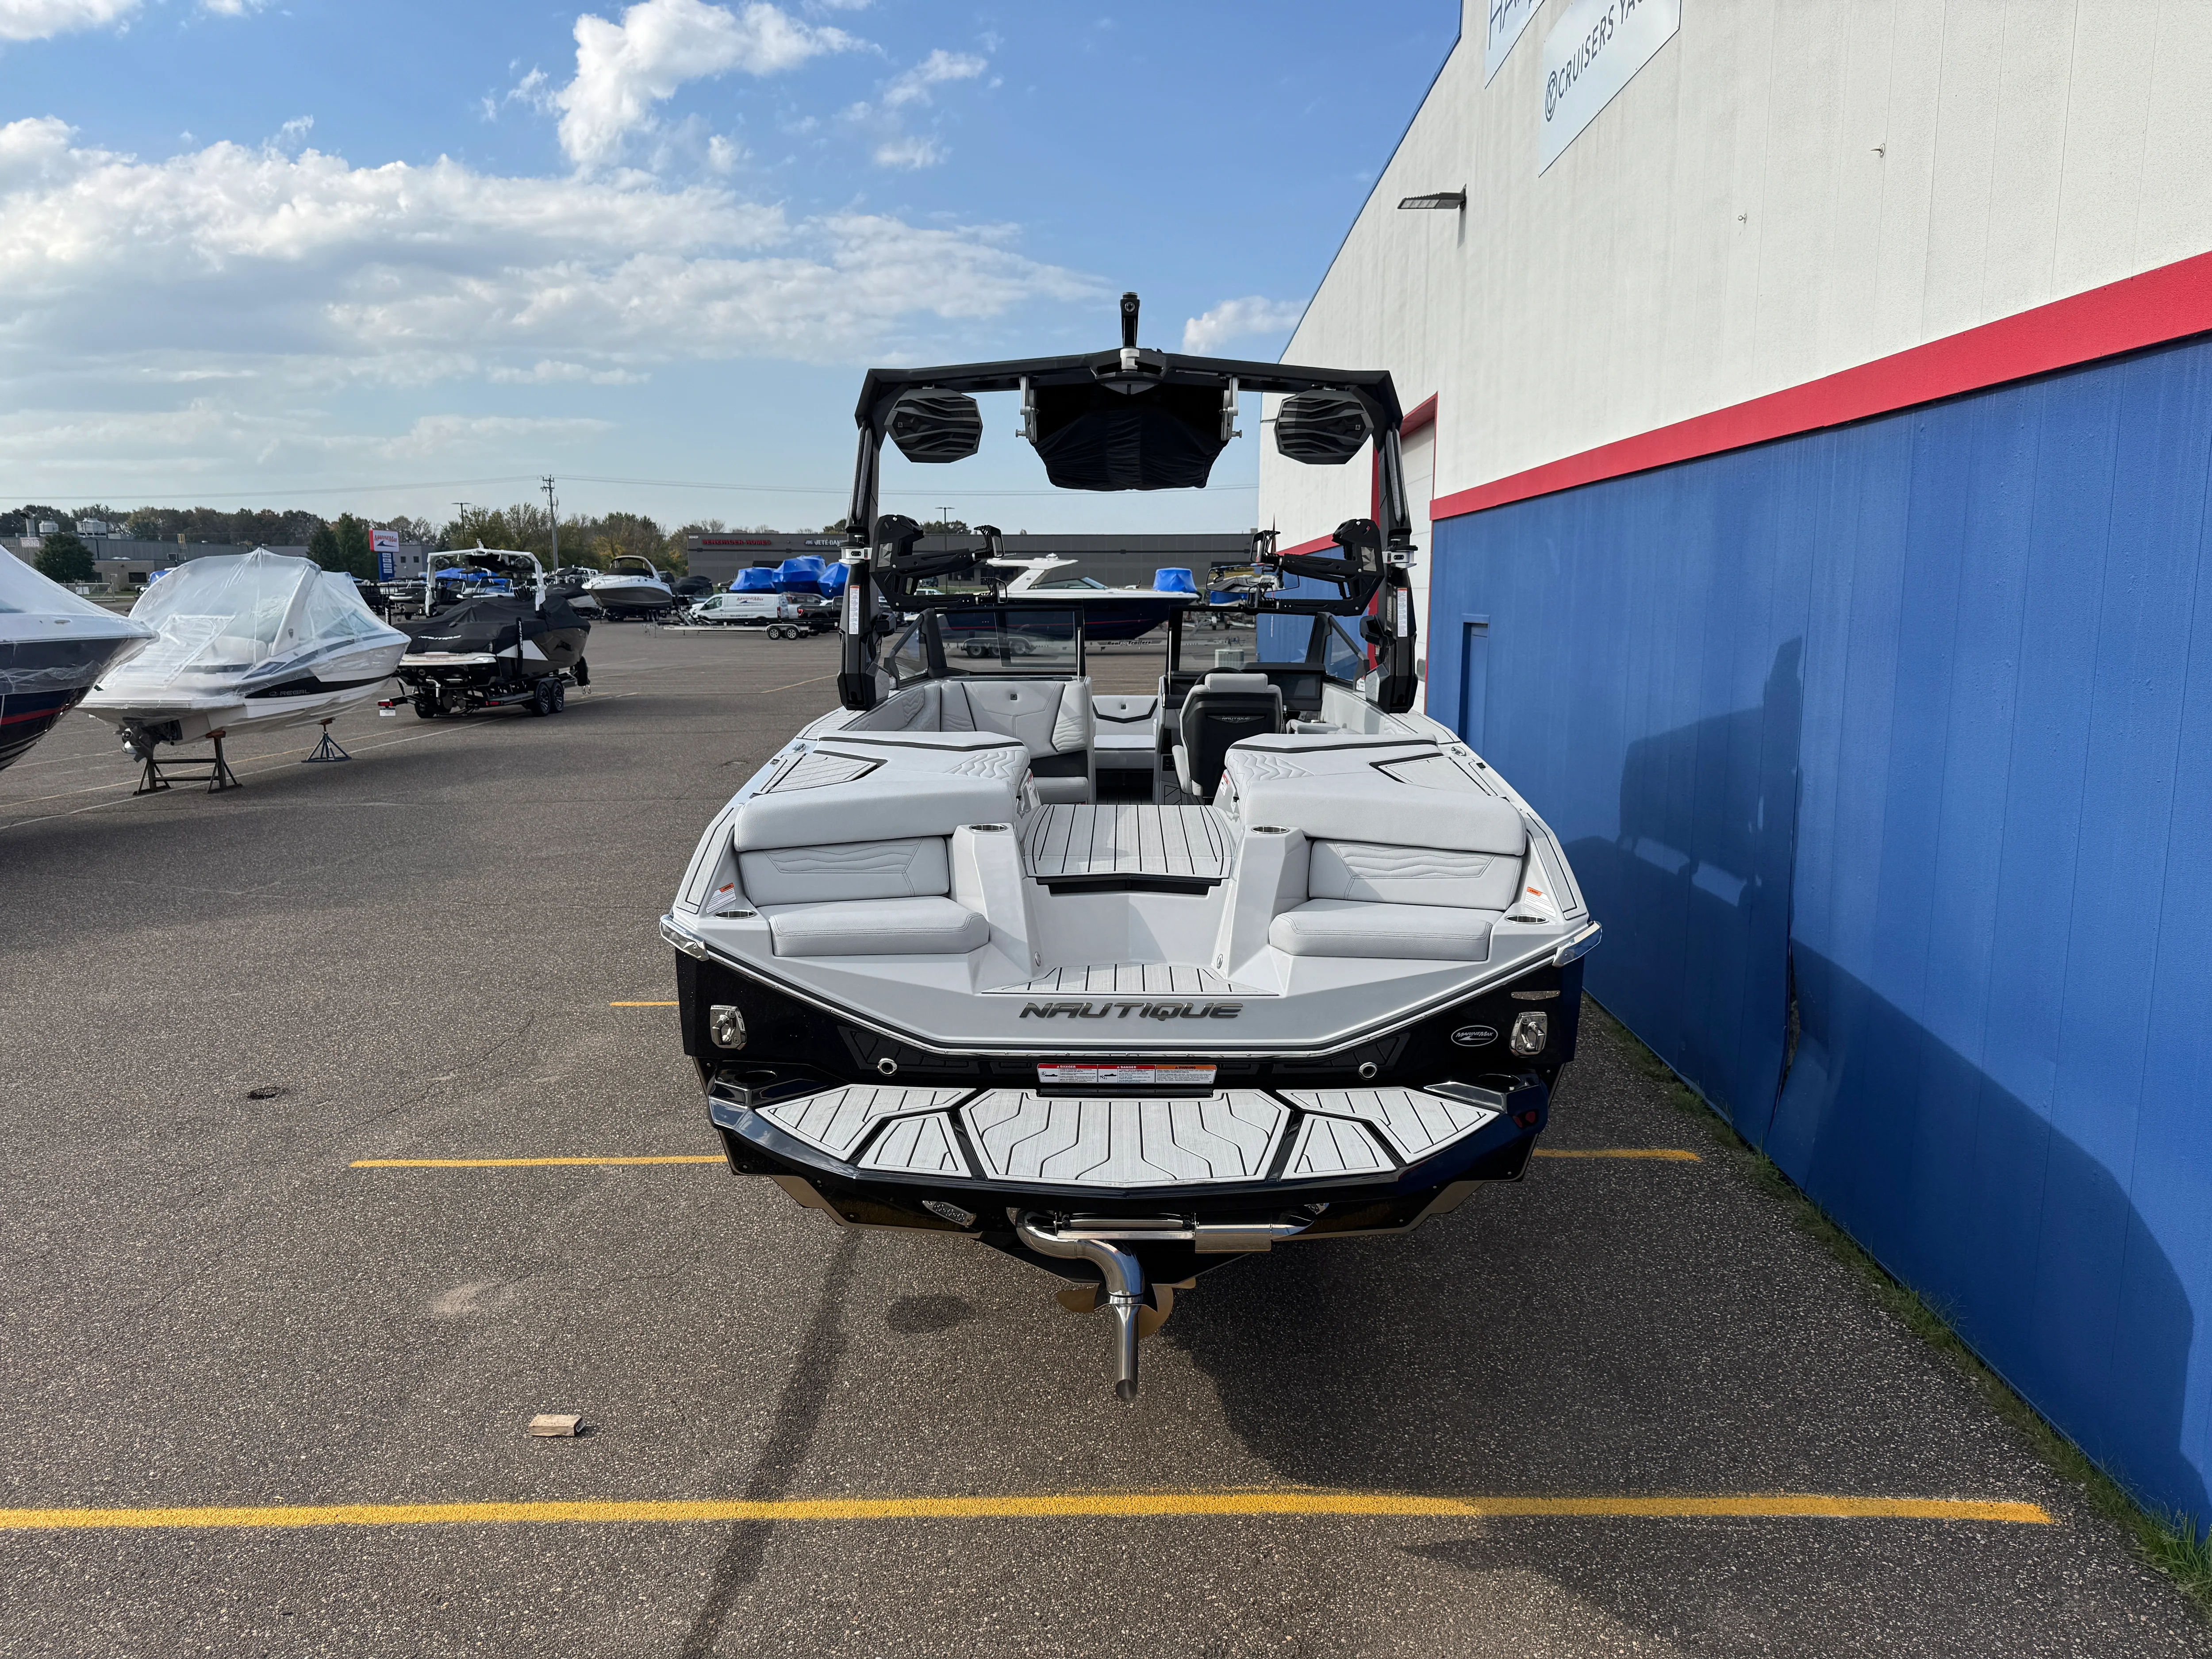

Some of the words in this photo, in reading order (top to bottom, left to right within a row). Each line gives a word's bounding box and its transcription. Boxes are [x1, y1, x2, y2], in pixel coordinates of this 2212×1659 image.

[1558, 4, 1614, 98] CRUISERS
[1620, 0, 1643, 25] YA
[1019, 1002, 1243, 1021] NAUTIQUE
